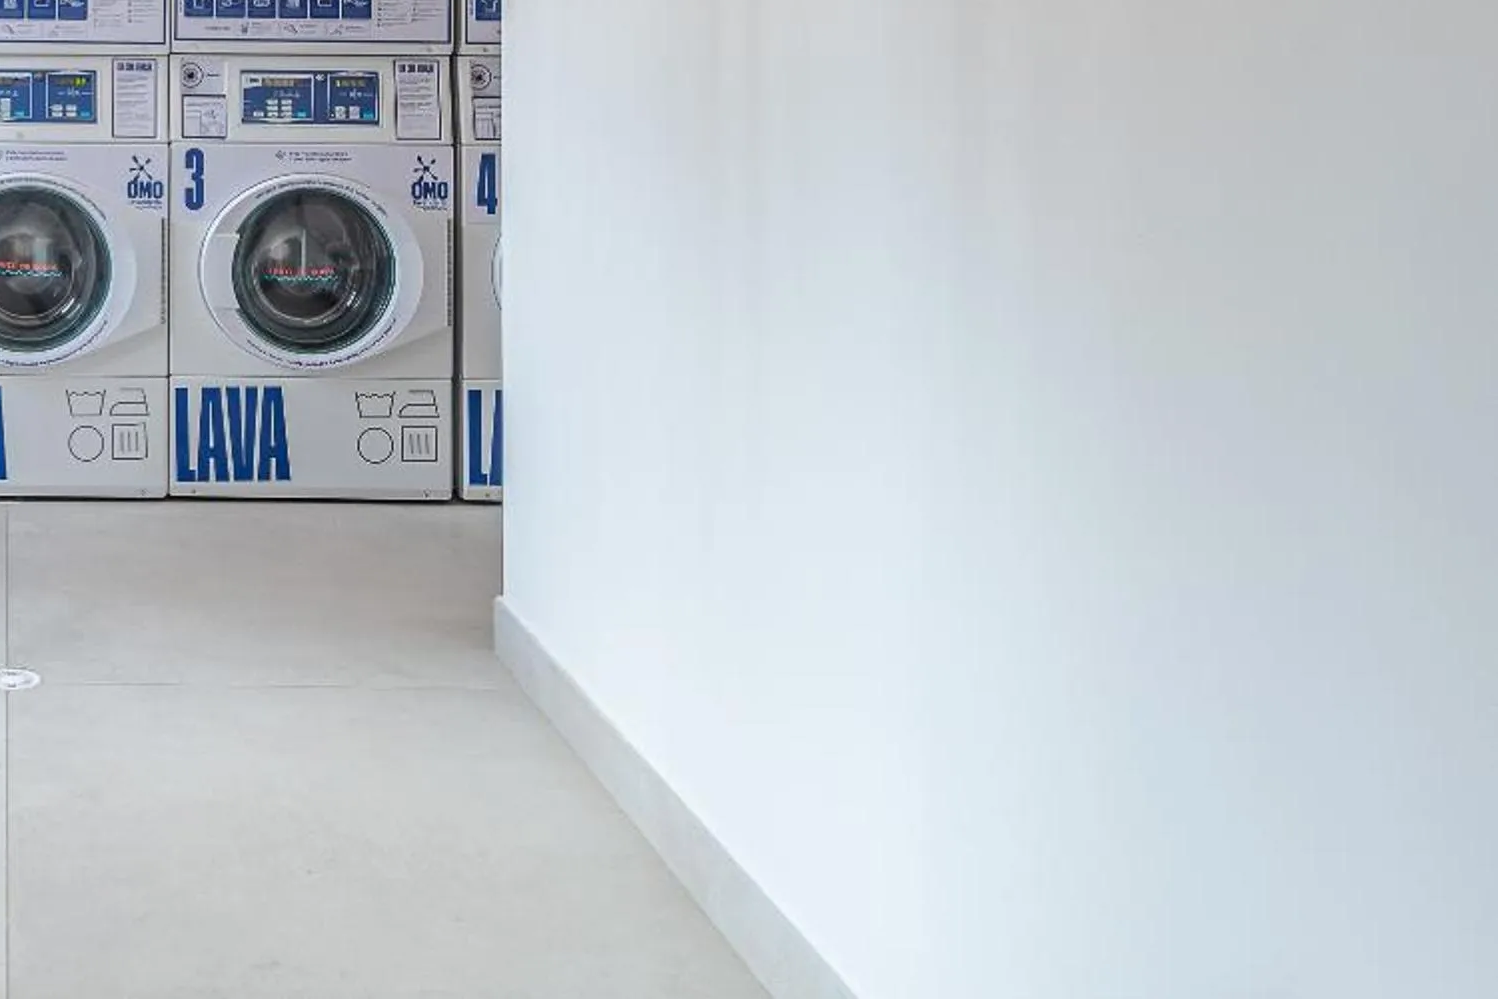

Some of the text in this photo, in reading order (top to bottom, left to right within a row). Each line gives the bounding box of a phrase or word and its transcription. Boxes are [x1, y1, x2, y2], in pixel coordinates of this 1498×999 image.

[127, 179, 164, 199] OMO
[184, 147, 205, 211] 3
[411, 180, 449, 200] OMO
[477, 153, 498, 215] 4
[174, 385, 292, 483] LAVA
